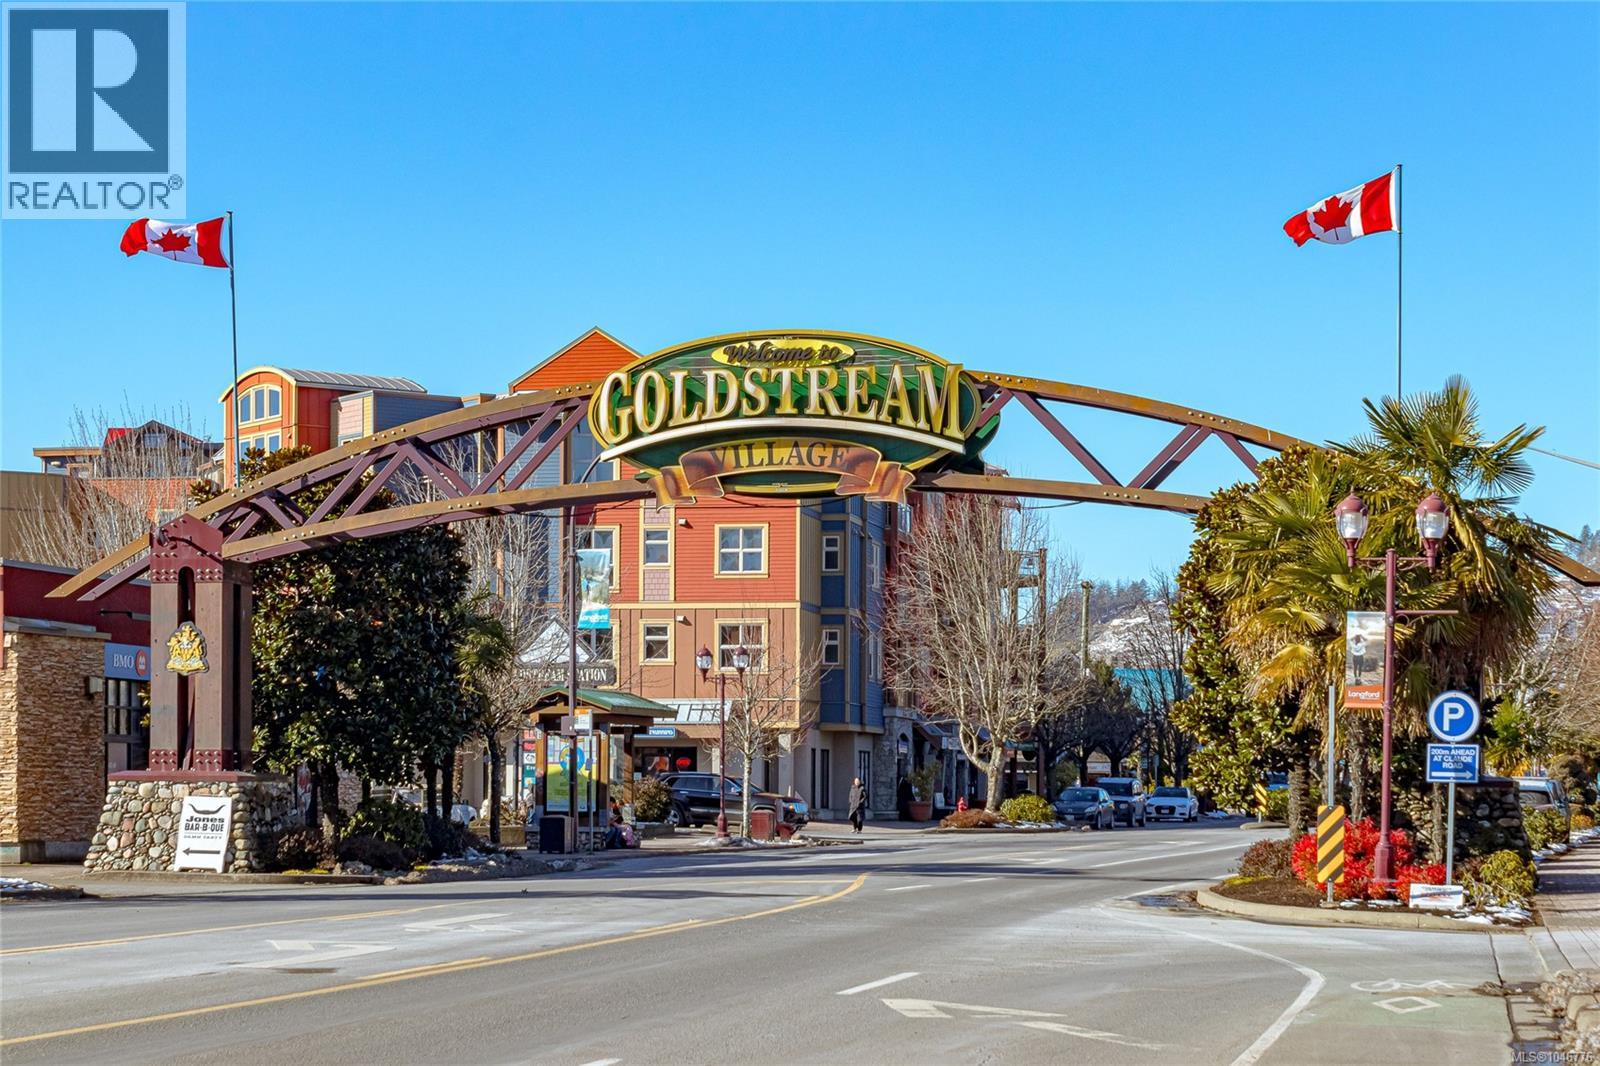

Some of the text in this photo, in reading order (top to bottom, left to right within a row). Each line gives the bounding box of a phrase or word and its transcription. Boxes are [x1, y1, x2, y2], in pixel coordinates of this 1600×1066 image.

[723, 341, 843, 364] Welcome to
[599, 363, 966, 442] GOLDSTREAM
[709, 440, 850, 471] VILLAGE
[113, 653, 134, 669] BMO
[1348, 690, 1380, 699] Langford
[1443, 702, 1465, 731] P
[1450, 748, 1476, 757] AHEAD
